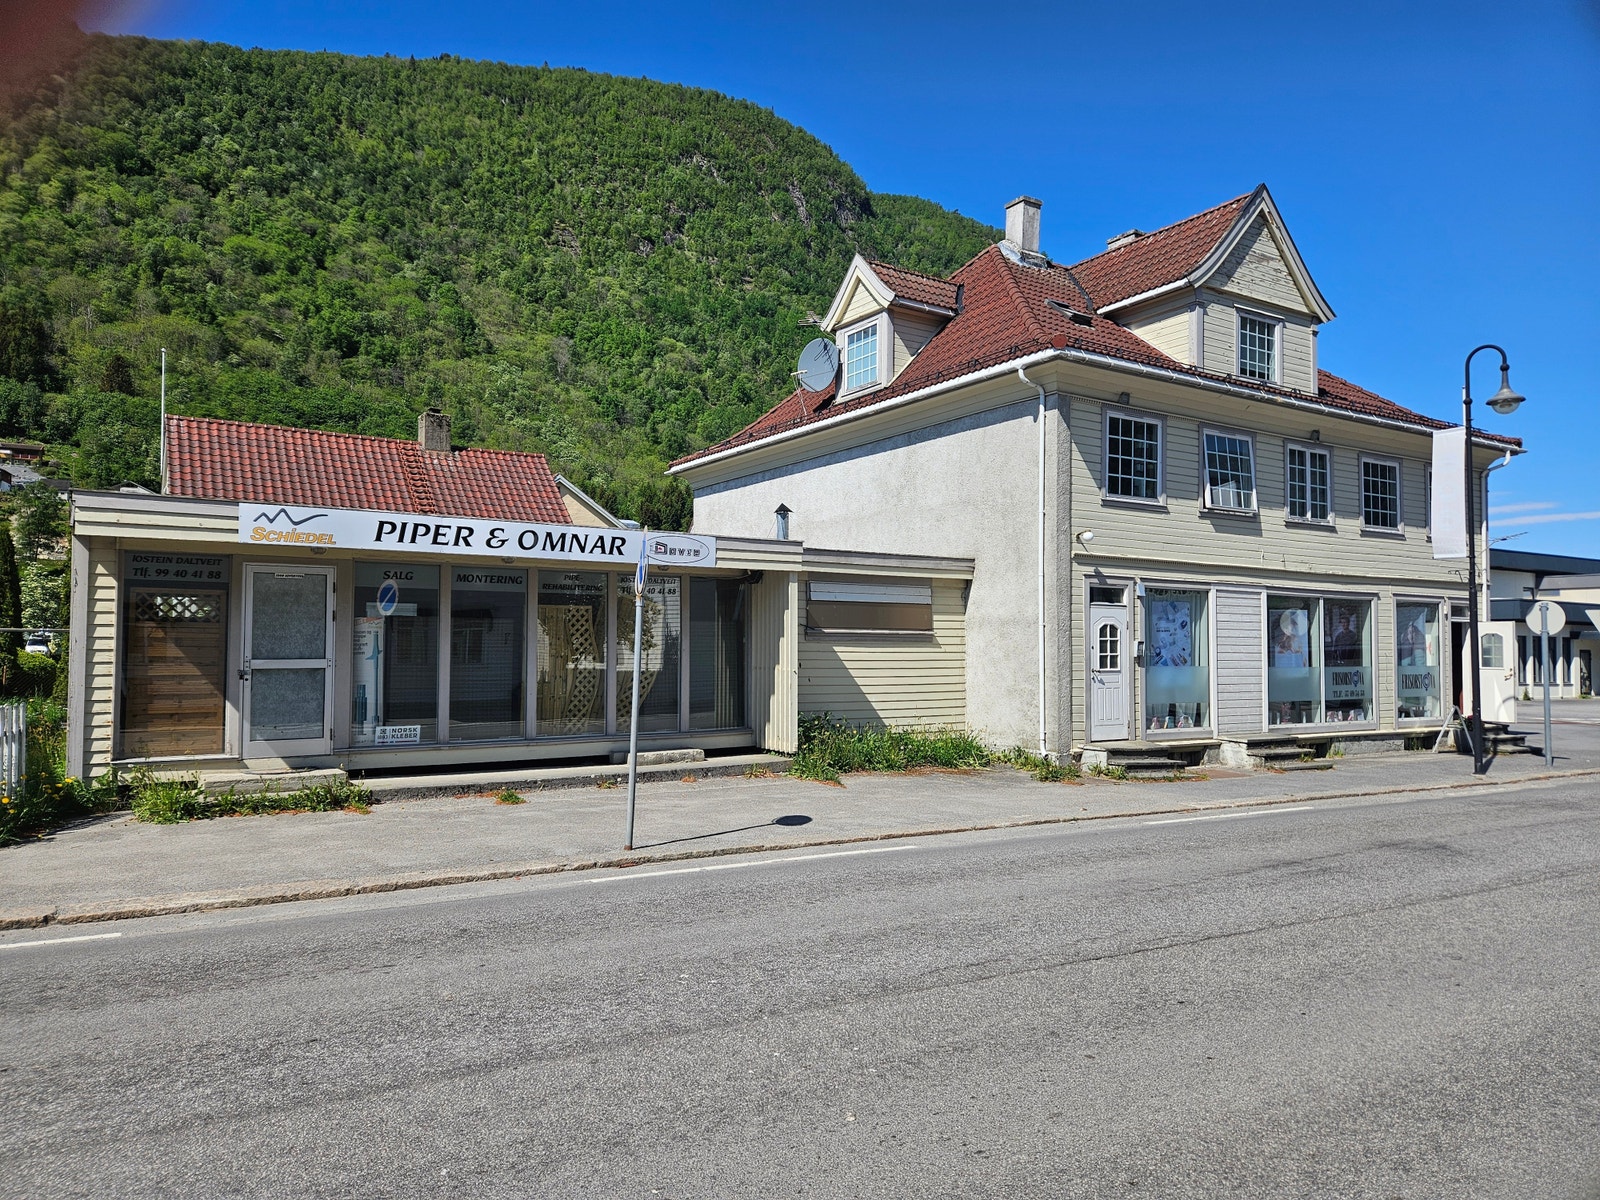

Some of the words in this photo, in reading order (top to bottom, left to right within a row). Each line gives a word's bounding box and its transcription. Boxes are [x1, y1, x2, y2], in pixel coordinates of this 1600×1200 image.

[373, 520, 475, 547] PIPER
[485, 527, 510, 549] &
[517, 529, 627, 556] OMNAR
[176, 557, 223, 566] DALTVEIT
[132, 567, 151, 578] Tlf.
[155, 568, 169, 577] 99
[173, 569, 187, 578] 40
[191, 570, 203, 578] 41
[207, 570, 221, 579] 88
[383, 570, 414, 580] SALG
[456, 573, 523, 585] MONTERING
[542, 583, 603, 592] REHABILITERING
